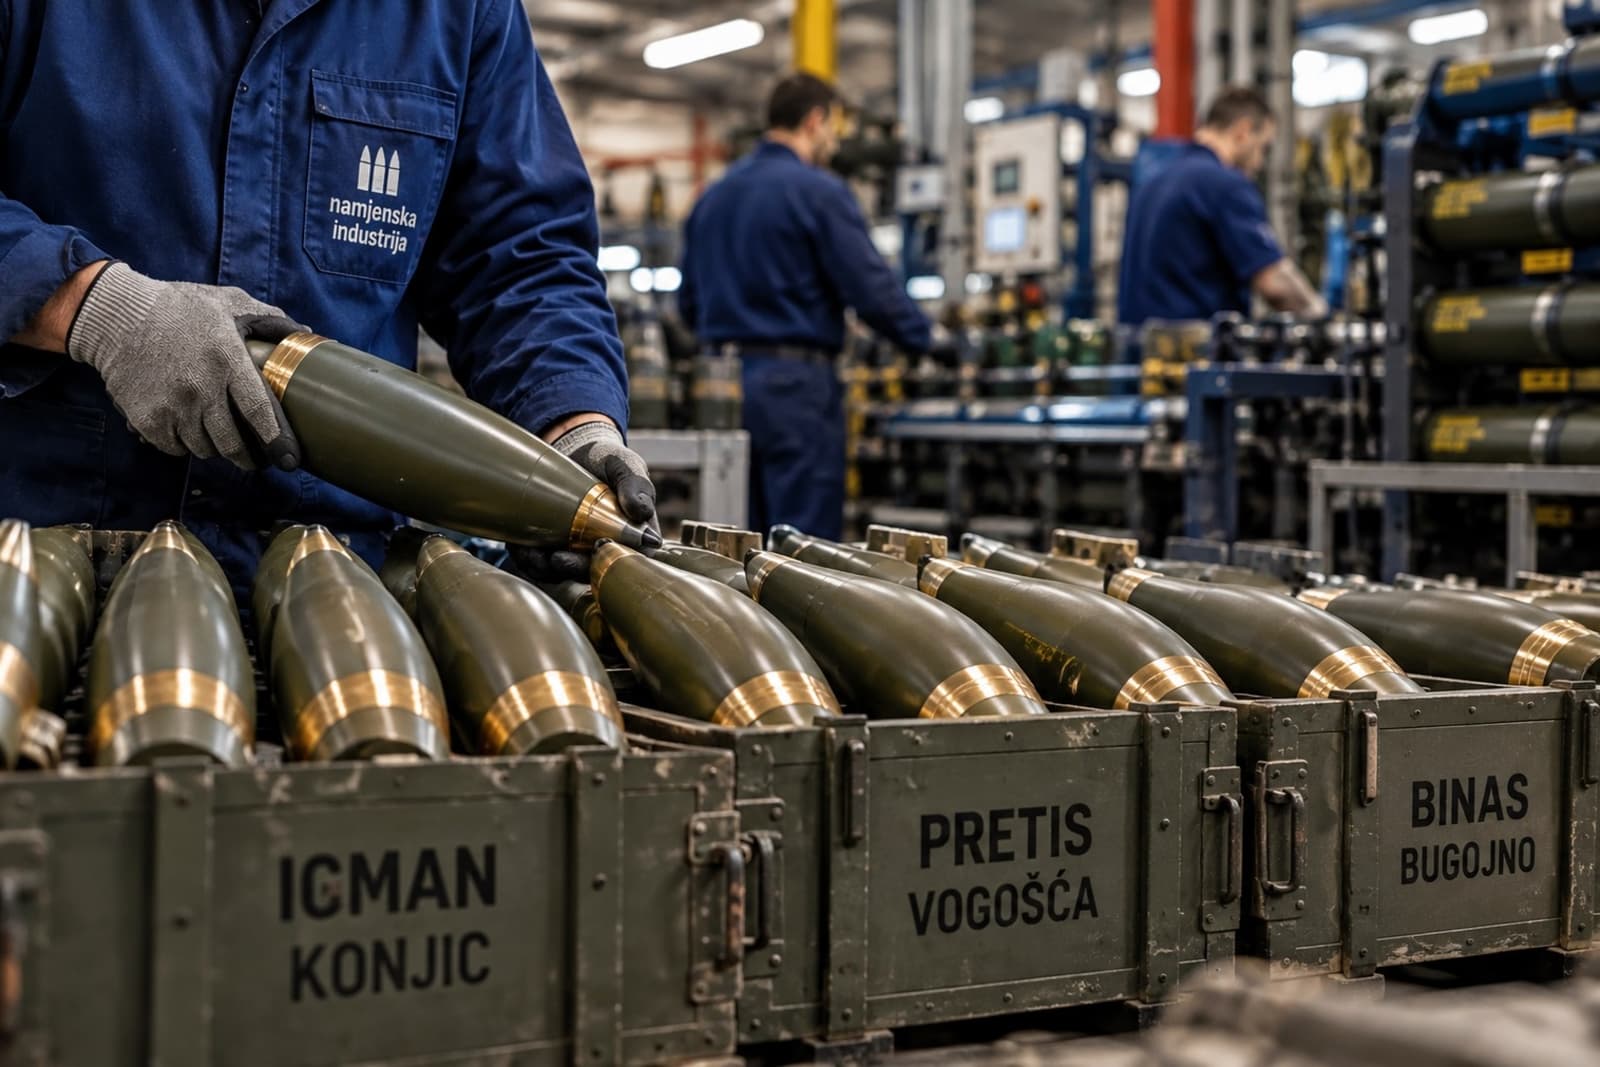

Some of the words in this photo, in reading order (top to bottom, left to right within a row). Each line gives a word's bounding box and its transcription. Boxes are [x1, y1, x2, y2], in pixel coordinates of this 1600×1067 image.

[329, 197, 417, 228] namjenska
[332, 219, 408, 255] industrija
[1412, 773, 1529, 828] BINAS
[920, 803, 1092, 869] PRETIS
[1401, 836, 1536, 885] BUGOJNO
[908, 869, 1099, 936] VOGOŠĆA
[291, 931, 491, 1003] KONJIC
